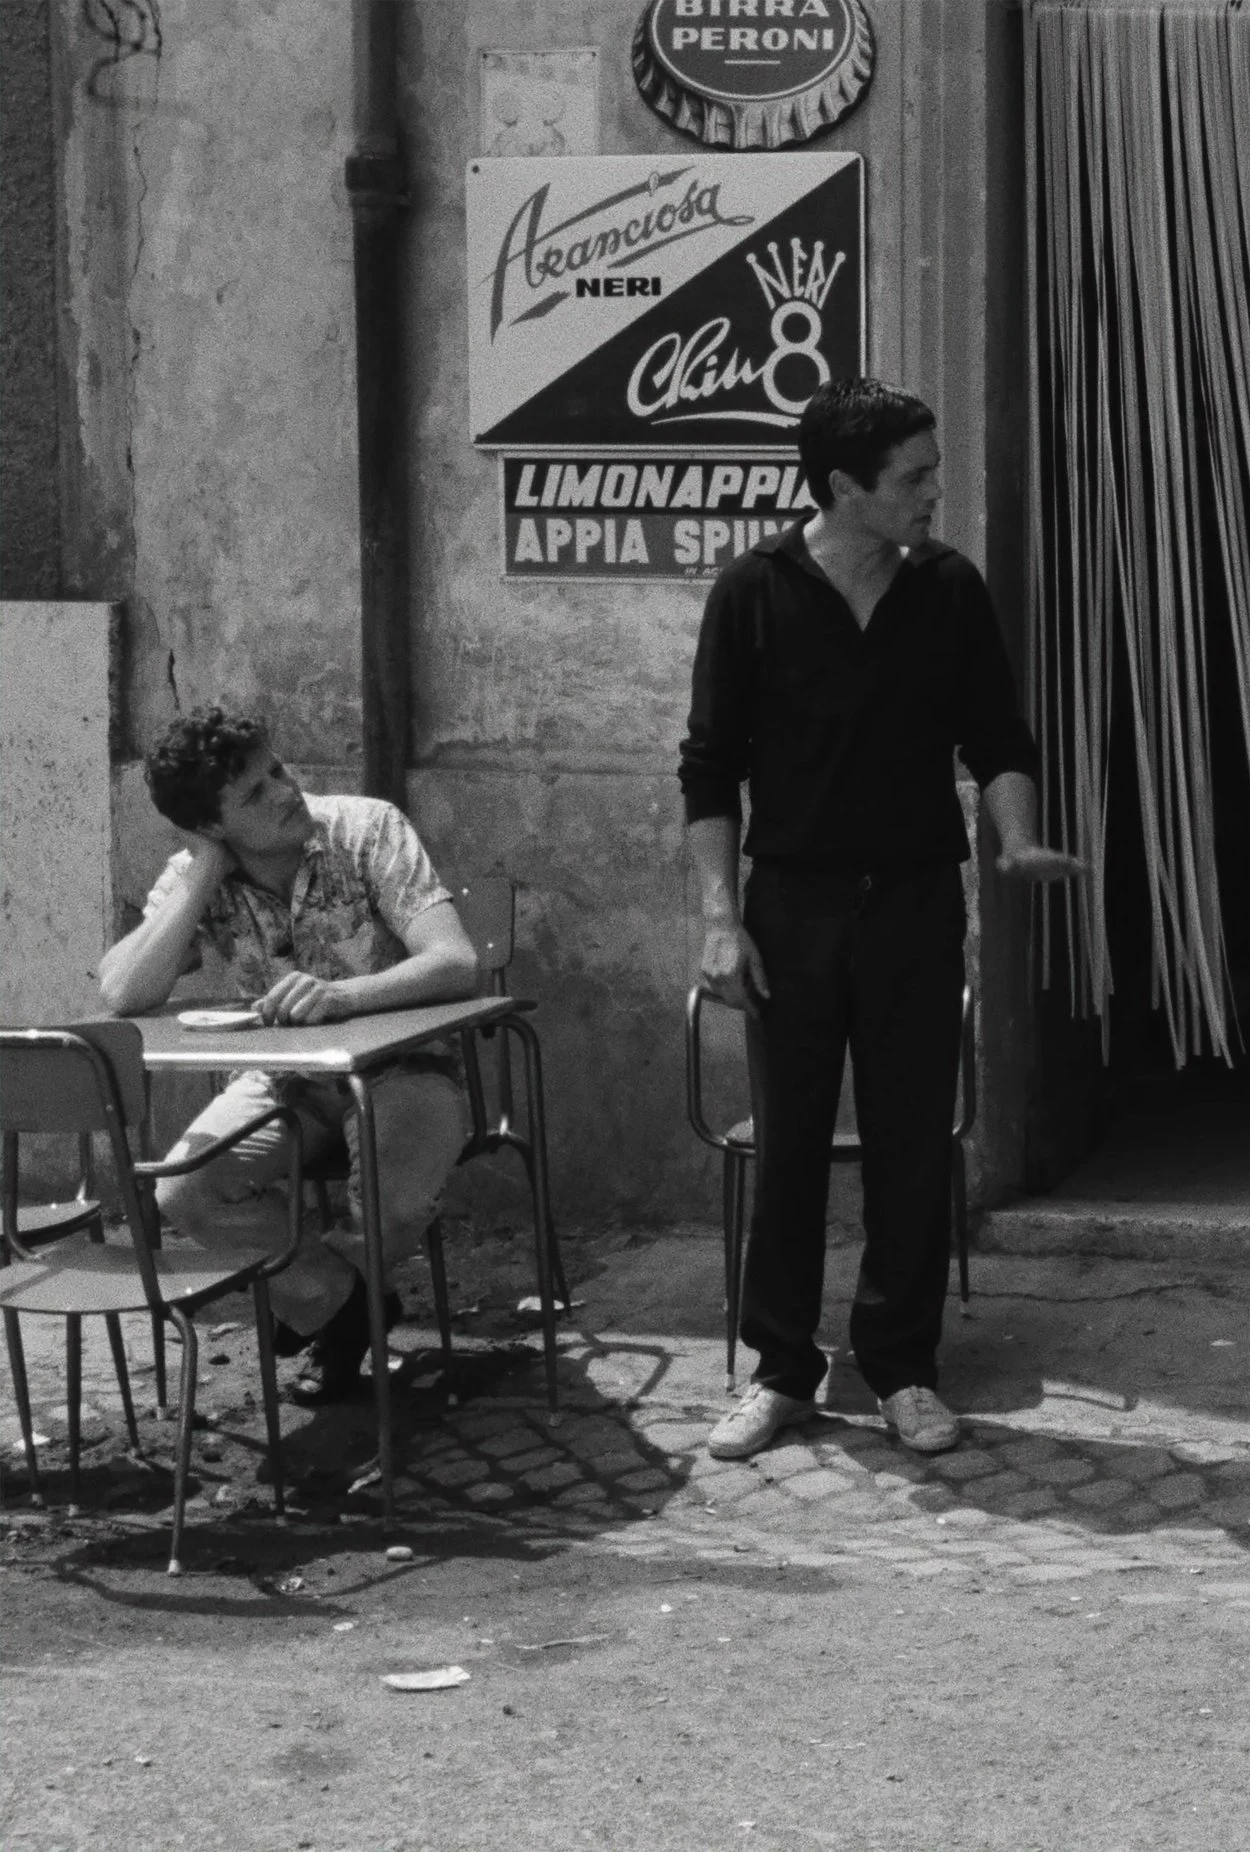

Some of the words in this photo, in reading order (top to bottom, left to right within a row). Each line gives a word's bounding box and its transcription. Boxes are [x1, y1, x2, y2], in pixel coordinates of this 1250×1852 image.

[675, 0, 830, 17] BIRRA
[672, 27, 835, 51] PERONI
[488, 165, 755, 346] Aranciosa
[746, 237, 847, 311] NERI
[575, 277, 662, 298] NERI
[514, 464, 821, 509] LIMONAPPIA
[514, 518, 650, 564] APPIA
